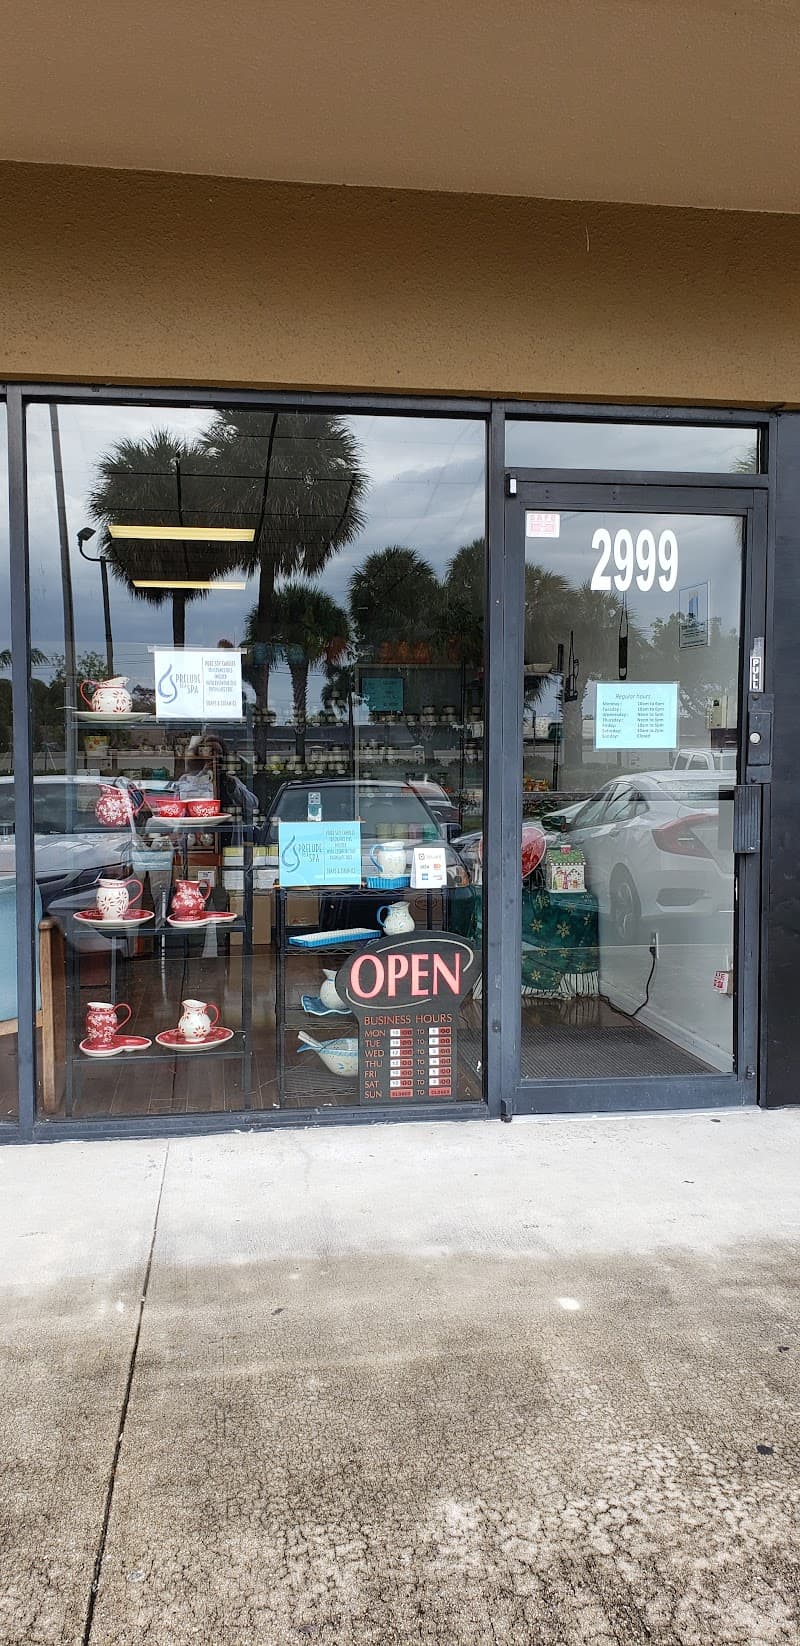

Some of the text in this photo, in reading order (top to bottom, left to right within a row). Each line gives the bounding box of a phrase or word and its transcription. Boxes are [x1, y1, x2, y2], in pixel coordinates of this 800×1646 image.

[590, 528, 678, 592] 2999
[187, 685, 199, 694] SPA
[309, 854, 320, 862] SPA
[350, 953, 461, 998] OPEN
[364, 1014, 453, 1025] BUSINESS HOURS
